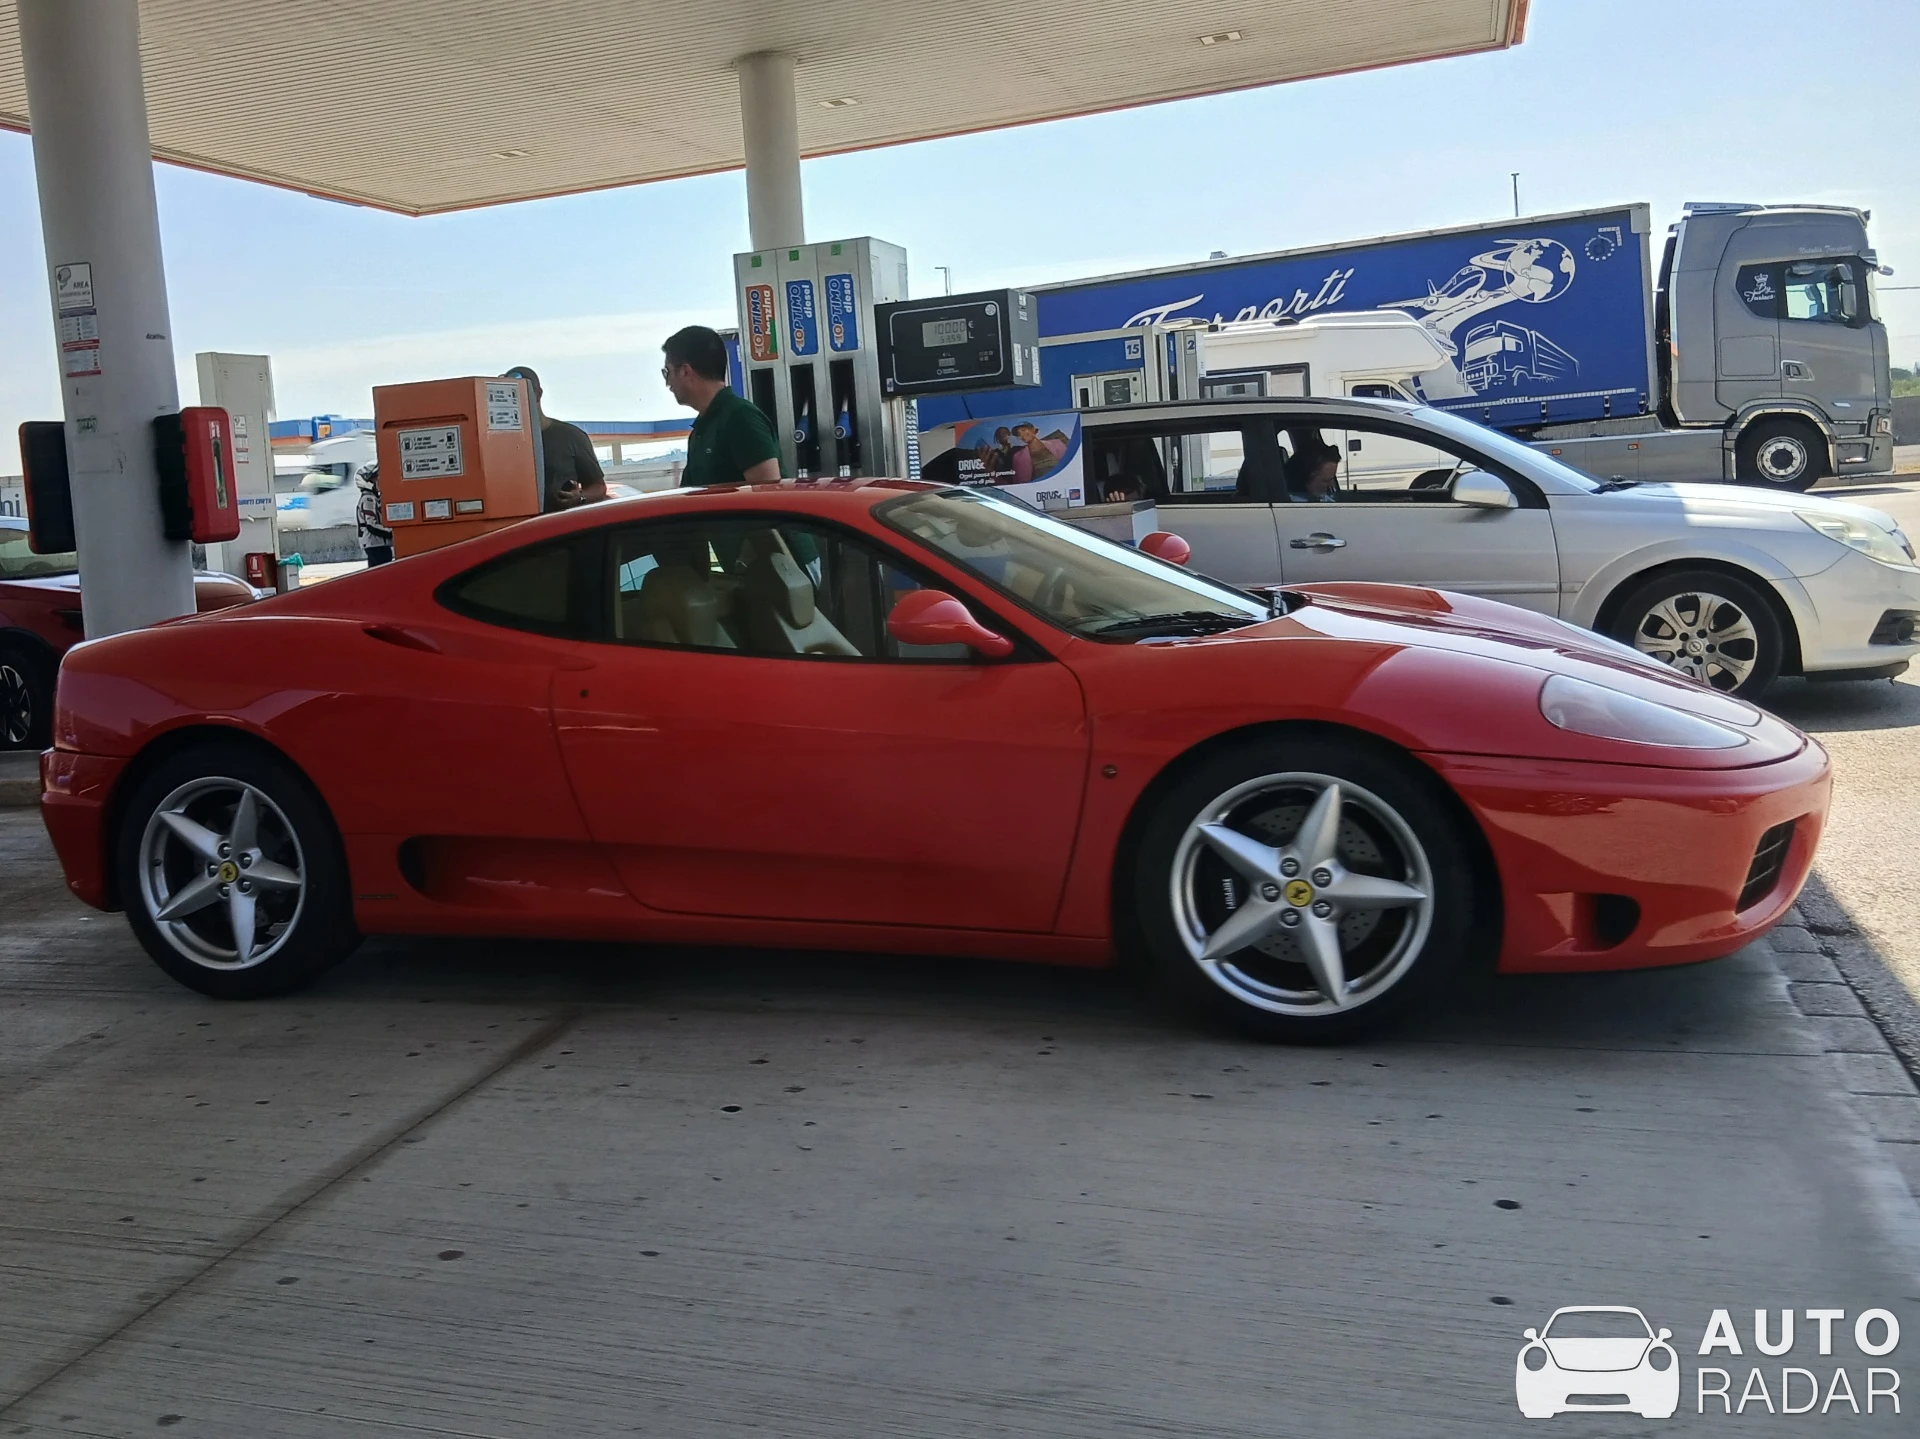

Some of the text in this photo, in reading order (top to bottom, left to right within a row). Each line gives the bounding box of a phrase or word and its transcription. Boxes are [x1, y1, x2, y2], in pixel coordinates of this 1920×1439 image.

[801, 284, 813, 318] diesel
[842, 278, 853, 313] diesel
[968, 331, 975, 339] L
[1126, 344, 1140, 355] 15
[1187, 340, 1195, 350] 2
